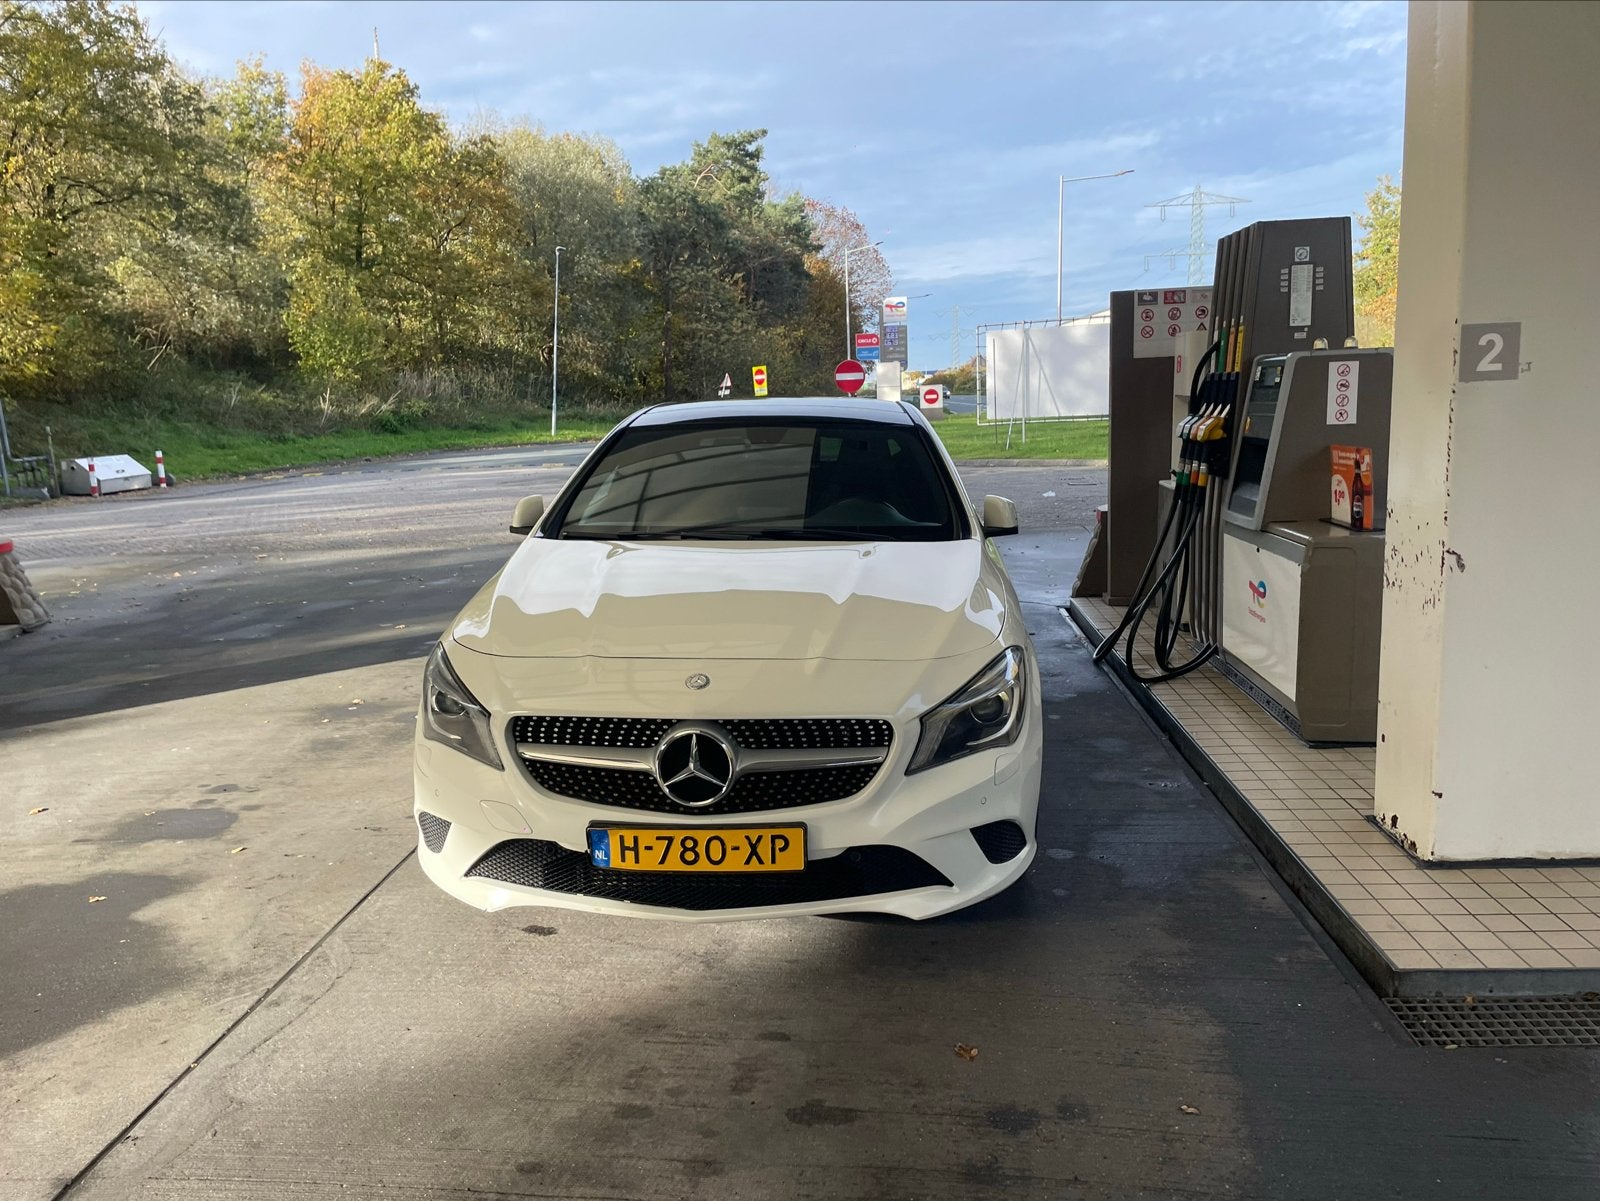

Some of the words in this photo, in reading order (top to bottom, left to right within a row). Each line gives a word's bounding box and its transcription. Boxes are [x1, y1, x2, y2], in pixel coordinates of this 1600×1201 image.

[1476, 333, 1504, 372] 2
[594, 849, 608, 860] NL
[619, 833, 790, 866] H-780-XP
